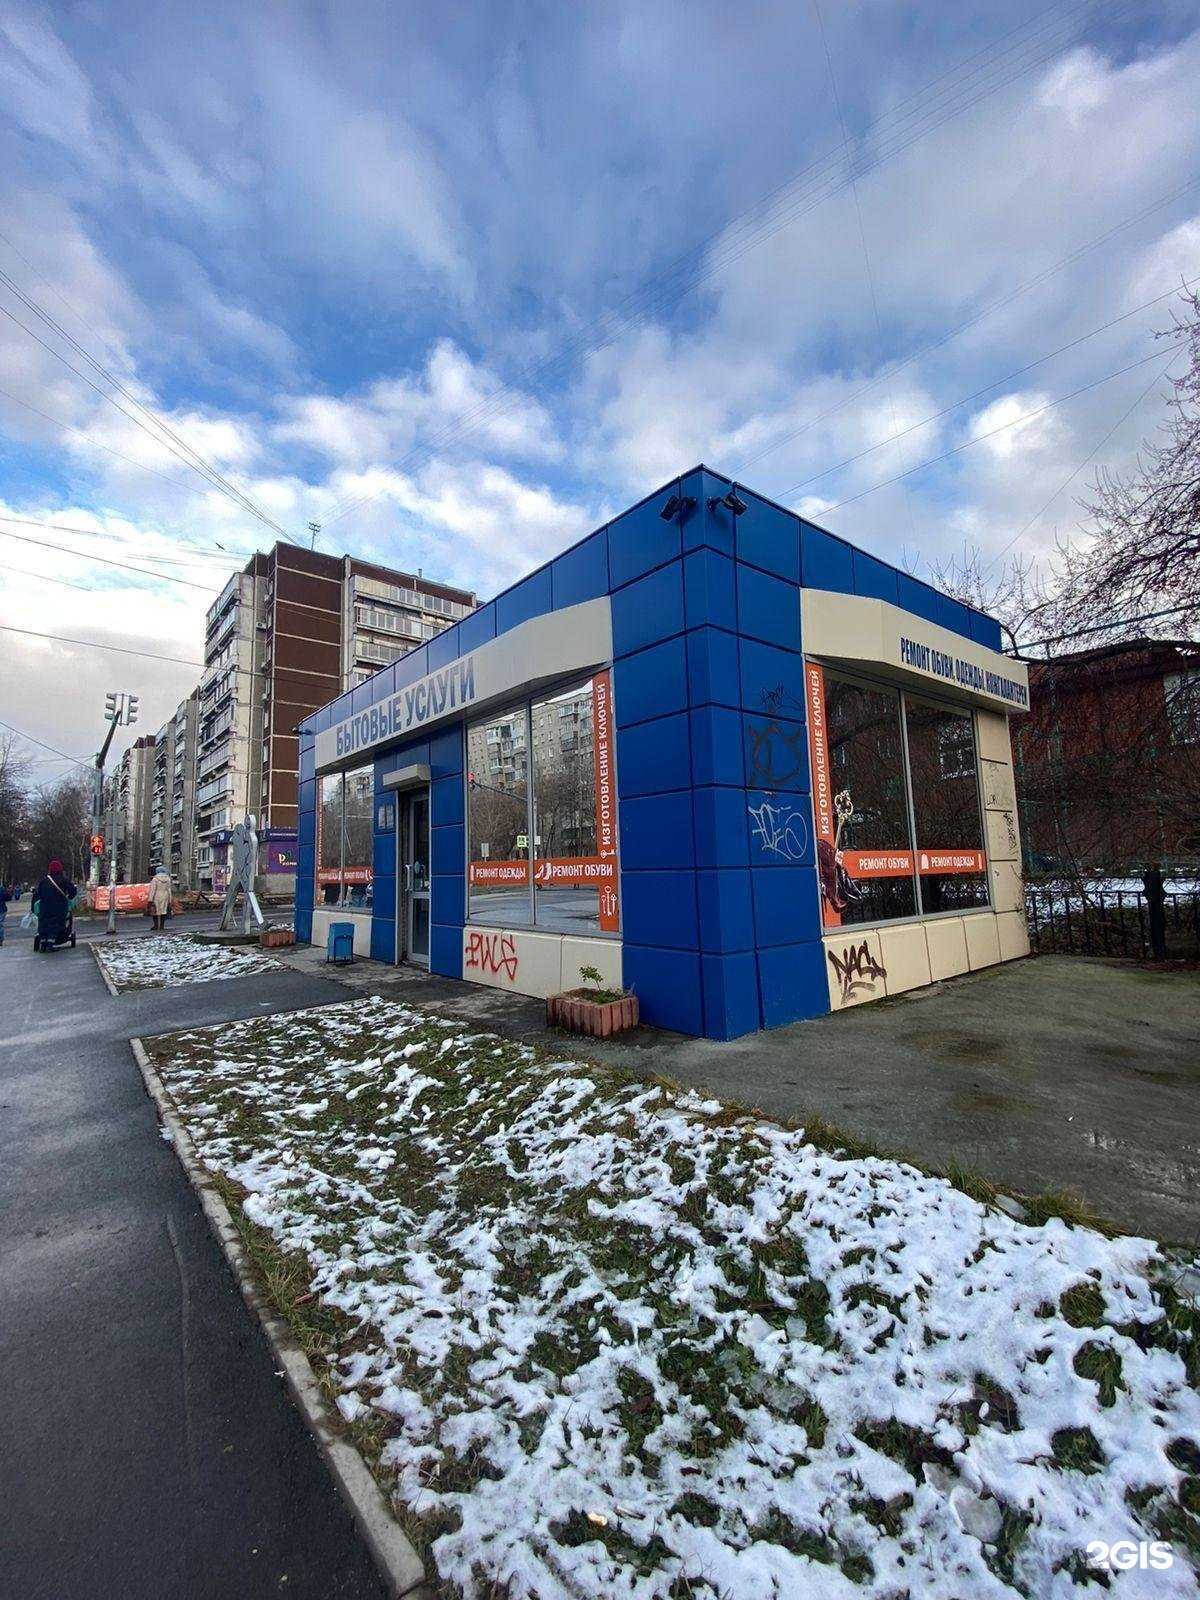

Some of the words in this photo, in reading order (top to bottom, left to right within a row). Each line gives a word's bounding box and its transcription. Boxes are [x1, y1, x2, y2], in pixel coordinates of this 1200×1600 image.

[900, 637, 931, 672] РЕМОНТ
[336, 698, 402, 756] БЫТОВЫЕ
[405, 657, 475, 727] УСЛУГИ
[597, 683, 608, 740] КЛЮЧЕЙ
[809, 669, 821, 727] КЛЮЧЕЙ
[600, 740, 611, 845] ИЗГОТОВЛЕНИЕ
[814, 728, 829, 835] ИЗГОТОВЛЕНИЕ
[476, 867, 499, 878] РЕМОНТ
[499, 866, 526, 880] ОДЕЖДЫ
[552, 865, 583, 877] РЕМОНТ
[585, 864, 613, 876] ОБУВИ
[859, 857, 887, 870] РЕМОНТ
[888, 857, 910, 869] ОБУВИ
[931, 856, 953, 867] РЕМОНТ
